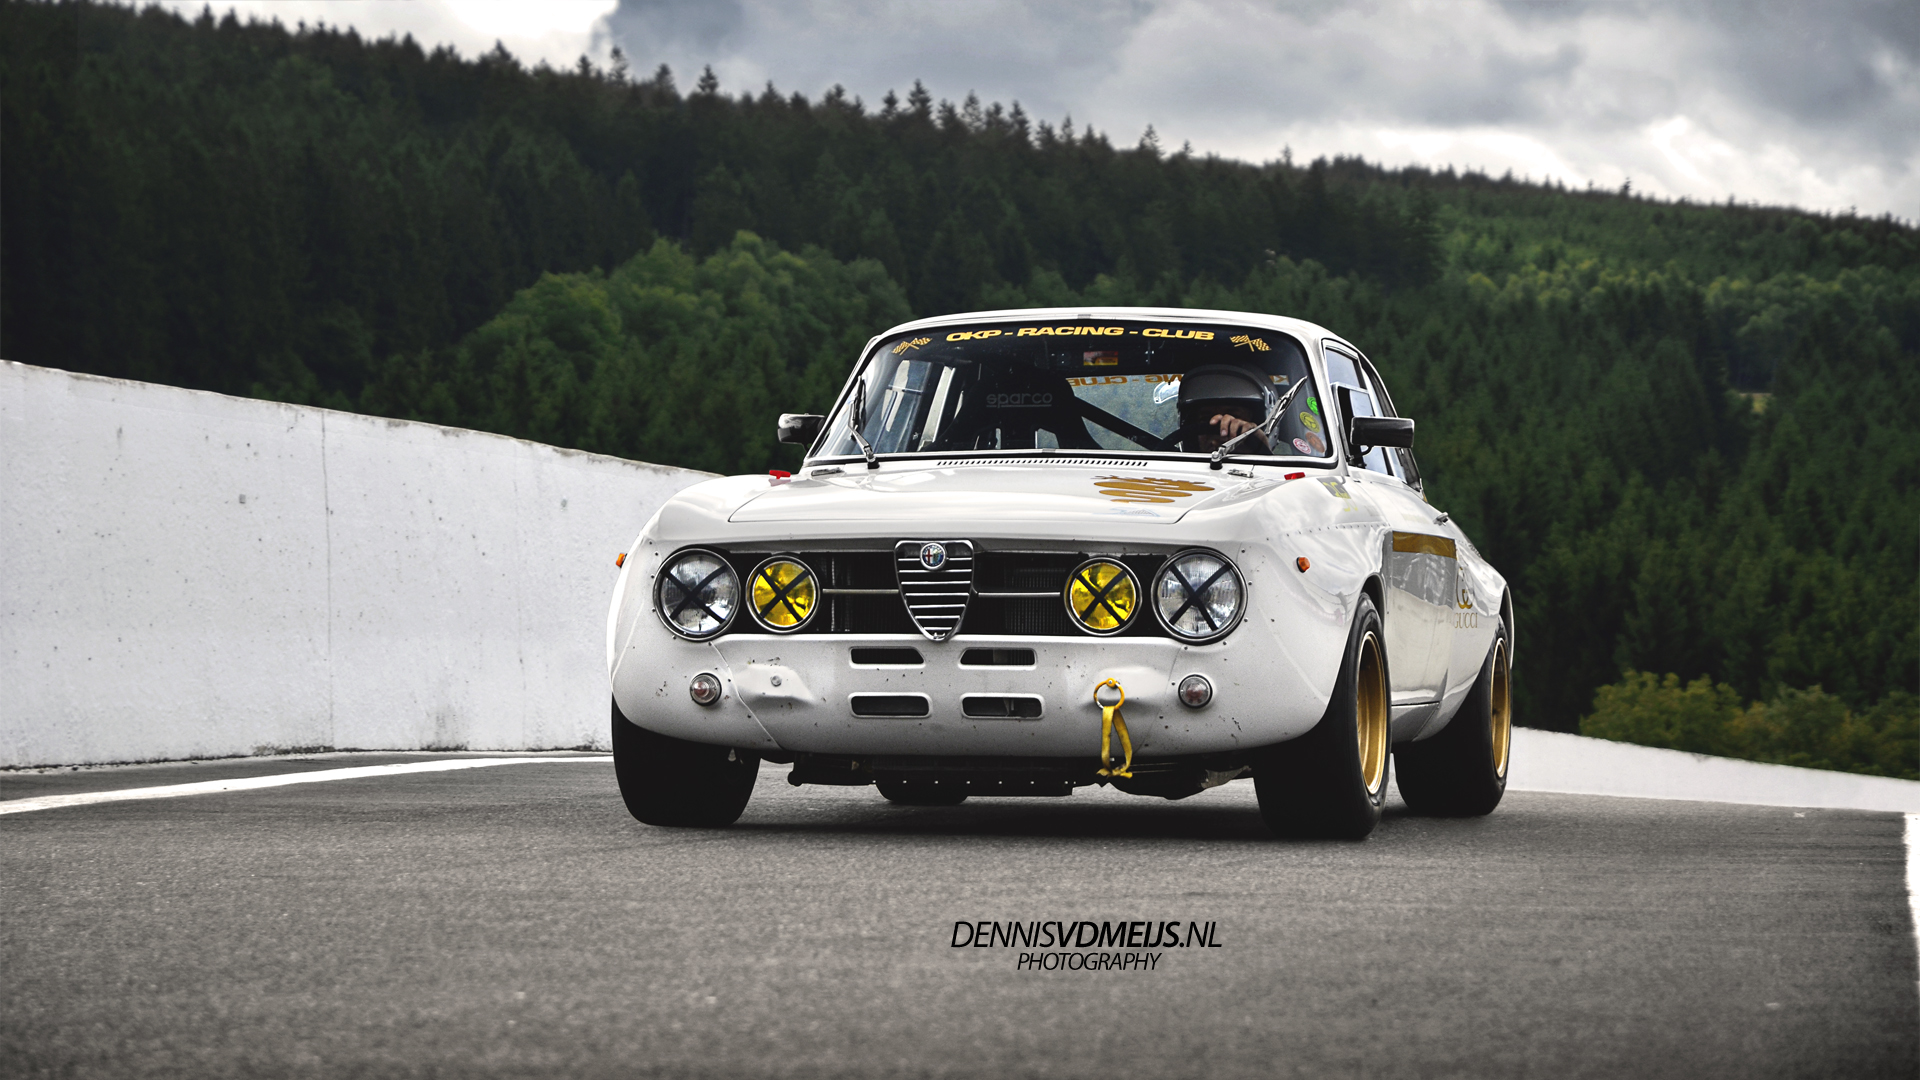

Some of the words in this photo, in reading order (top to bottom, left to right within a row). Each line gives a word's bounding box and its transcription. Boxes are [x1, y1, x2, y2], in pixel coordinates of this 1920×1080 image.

[946, 330, 1002, 342] OKP
[1017, 326, 1125, 337] RACING
[1142, 328, 1215, 341] CLUB
[986, 392, 1053, 409] sparco
[1453, 612, 1478, 629] GUCCI
